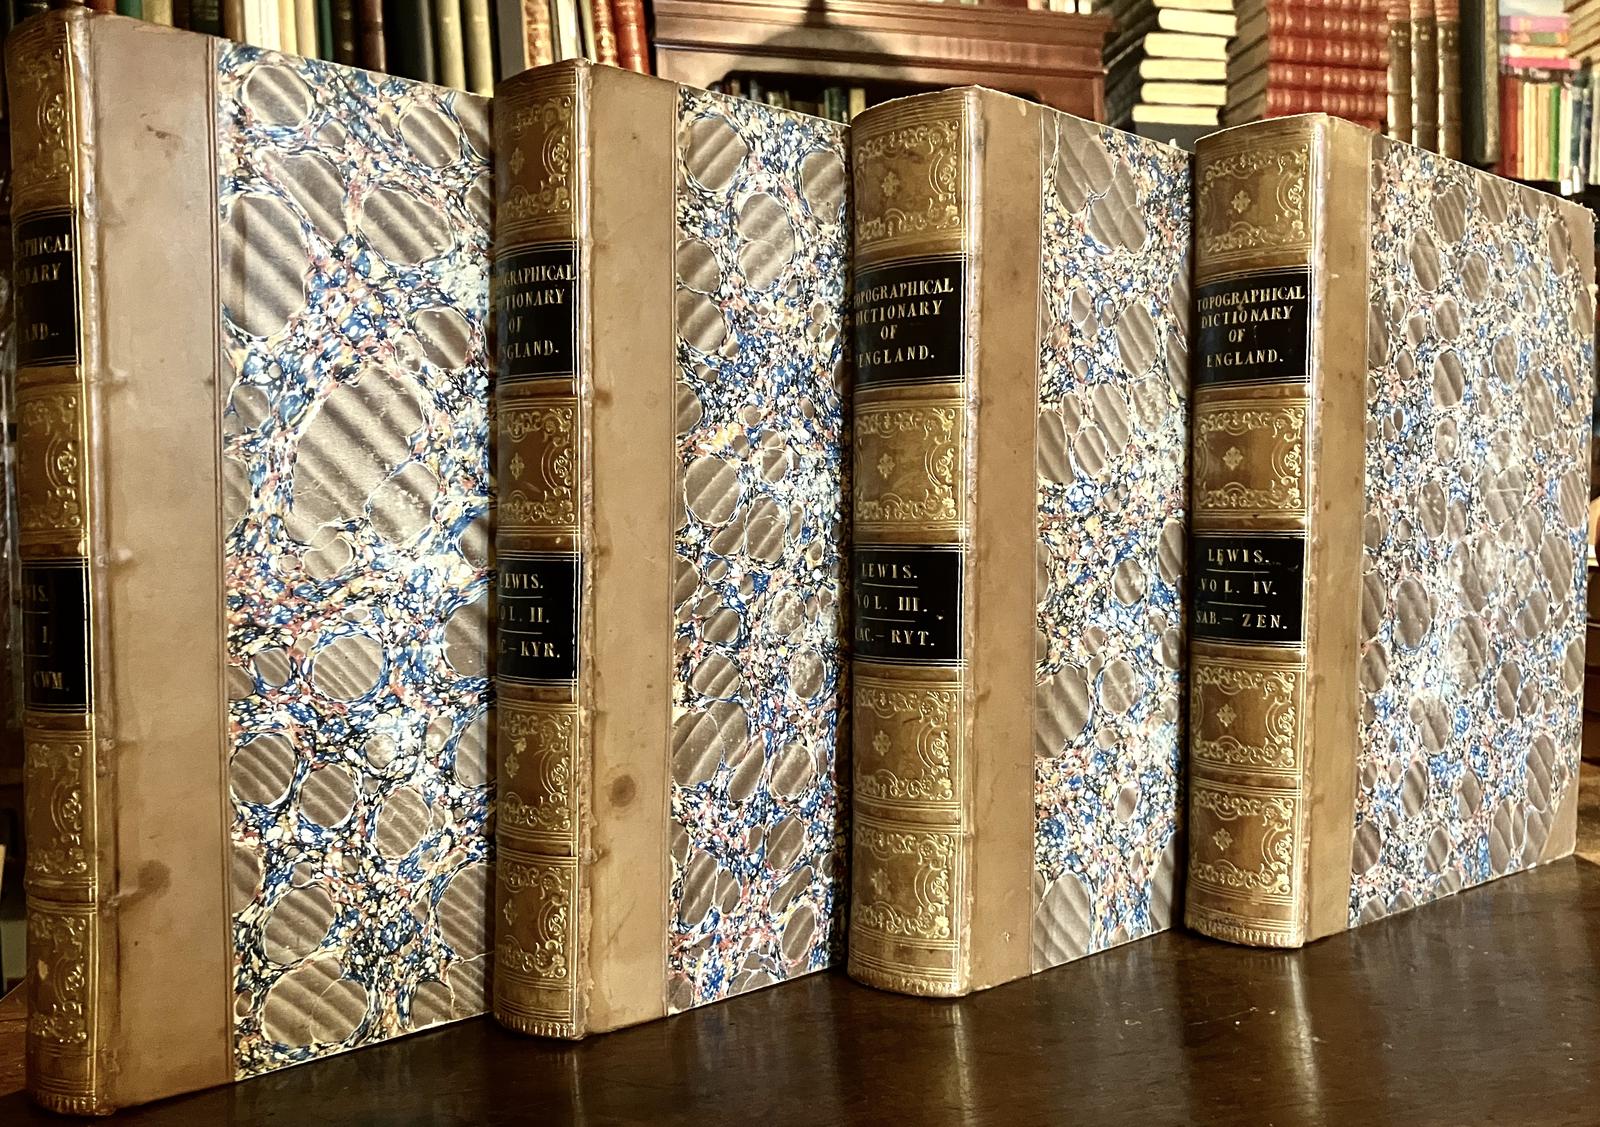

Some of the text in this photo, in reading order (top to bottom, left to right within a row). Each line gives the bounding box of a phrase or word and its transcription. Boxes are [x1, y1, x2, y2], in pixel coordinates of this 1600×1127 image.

[506, 288, 565, 311] TIONARY
[1197, 286, 1306, 312] TOPOGRAPHICAL
[508, 315, 523, 335] OF
[1201, 305, 1294, 329] DICTIONARY
[880, 324, 898, 340] OF
[1228, 328, 1245, 343] OF
[858, 344, 935, 368] ENGLAND.
[1206, 348, 1284, 368] ENGLAND.
[1208, 548, 1270, 564] LEWIS.
[861, 562, 918, 579] LEWIS.
[1201, 578, 1278, 595] VOL. IV.
[898, 596, 928, 613] III.
[529, 606, 551, 624] II.
[1242, 613, 1288, 630] ZEN.
[891, 629, 935, 647] RYT.
[520, 640, 561, 659] KYR.
